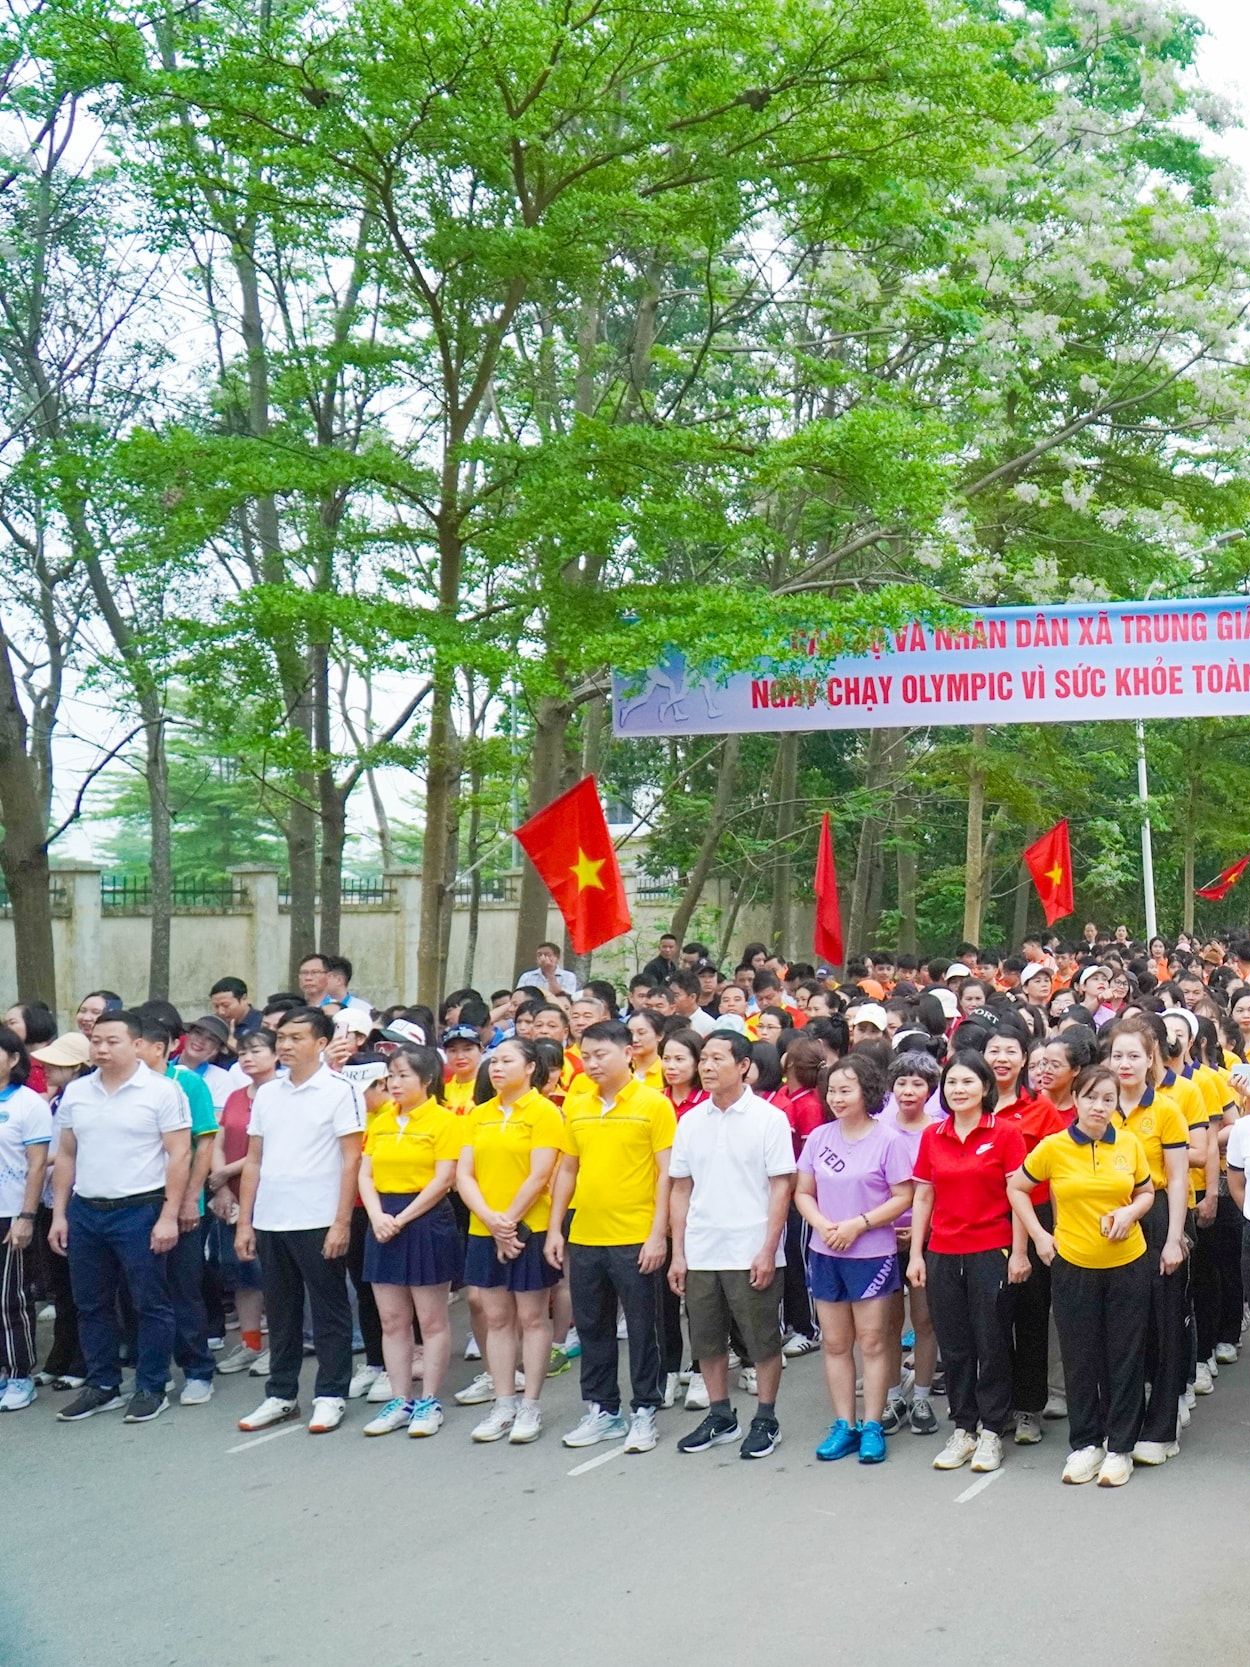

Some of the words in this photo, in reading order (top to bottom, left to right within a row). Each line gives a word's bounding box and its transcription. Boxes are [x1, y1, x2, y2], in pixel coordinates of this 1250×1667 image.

[1016, 613, 1069, 648] DÂN
[1079, 611, 1112, 646] XÃ
[1120, 613, 1207, 645] TRUNG
[827, 676, 893, 711] CHẠY
[902, 671, 1013, 704] OLYMPIC
[1022, 664, 1045, 700] VÌ
[1055, 663, 1106, 699] SỨC
[1115, 656, 1184, 697] KHỎE
